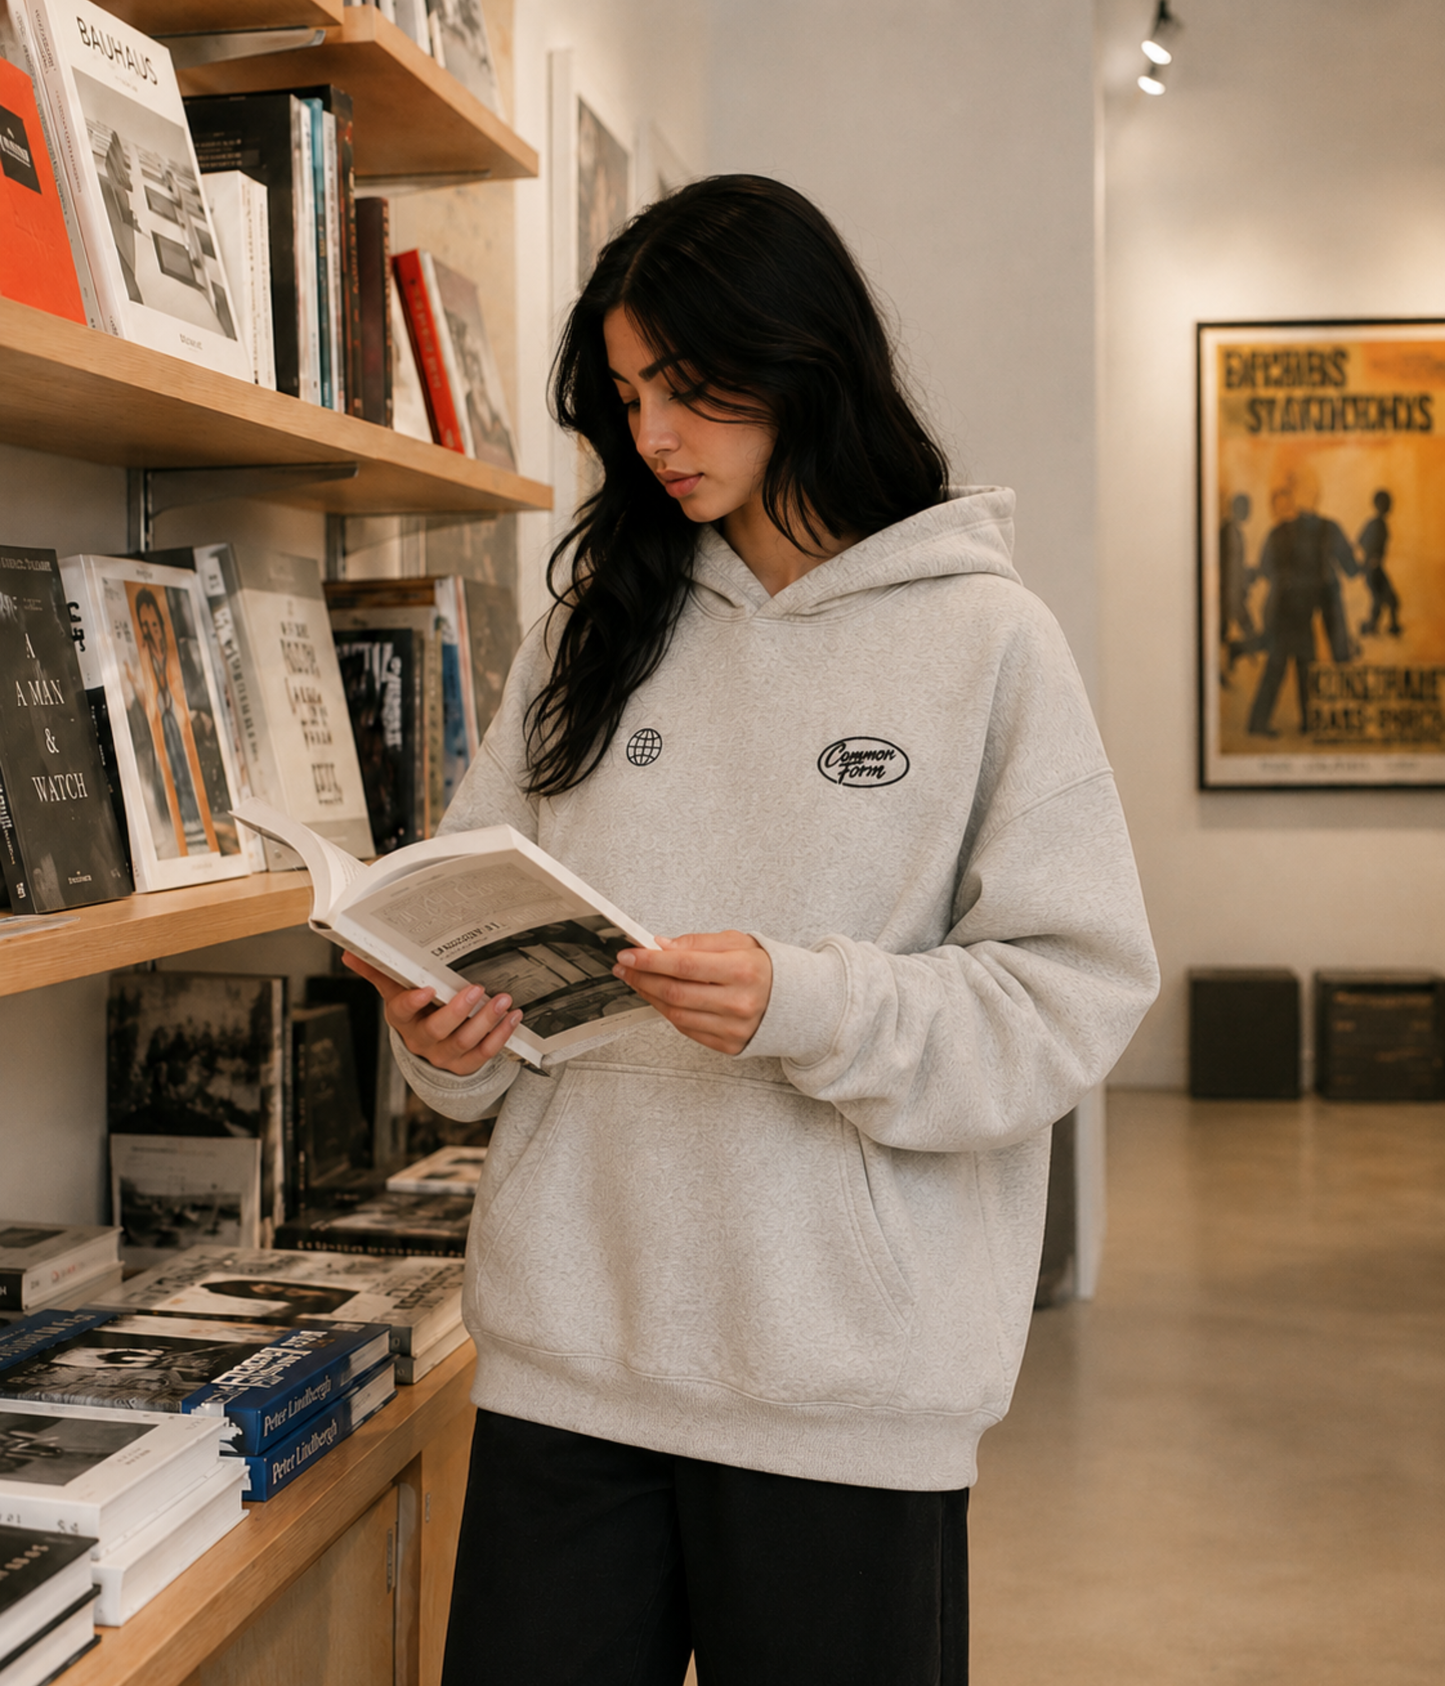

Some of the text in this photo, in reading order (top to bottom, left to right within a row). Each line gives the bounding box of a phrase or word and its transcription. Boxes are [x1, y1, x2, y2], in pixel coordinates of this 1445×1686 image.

[76, 15, 158, 86] BAUHAUS
[15, 679, 65, 707] A MAN
[44, 728, 60, 754] &
[825, 742, 896, 768] Common
[838, 761, 886, 784] Form
[31, 772, 89, 803] WATCH
[263, 1375, 331, 1438] Peter Lindbergh
[272, 1418, 338, 1485] Peter Lindbergh
